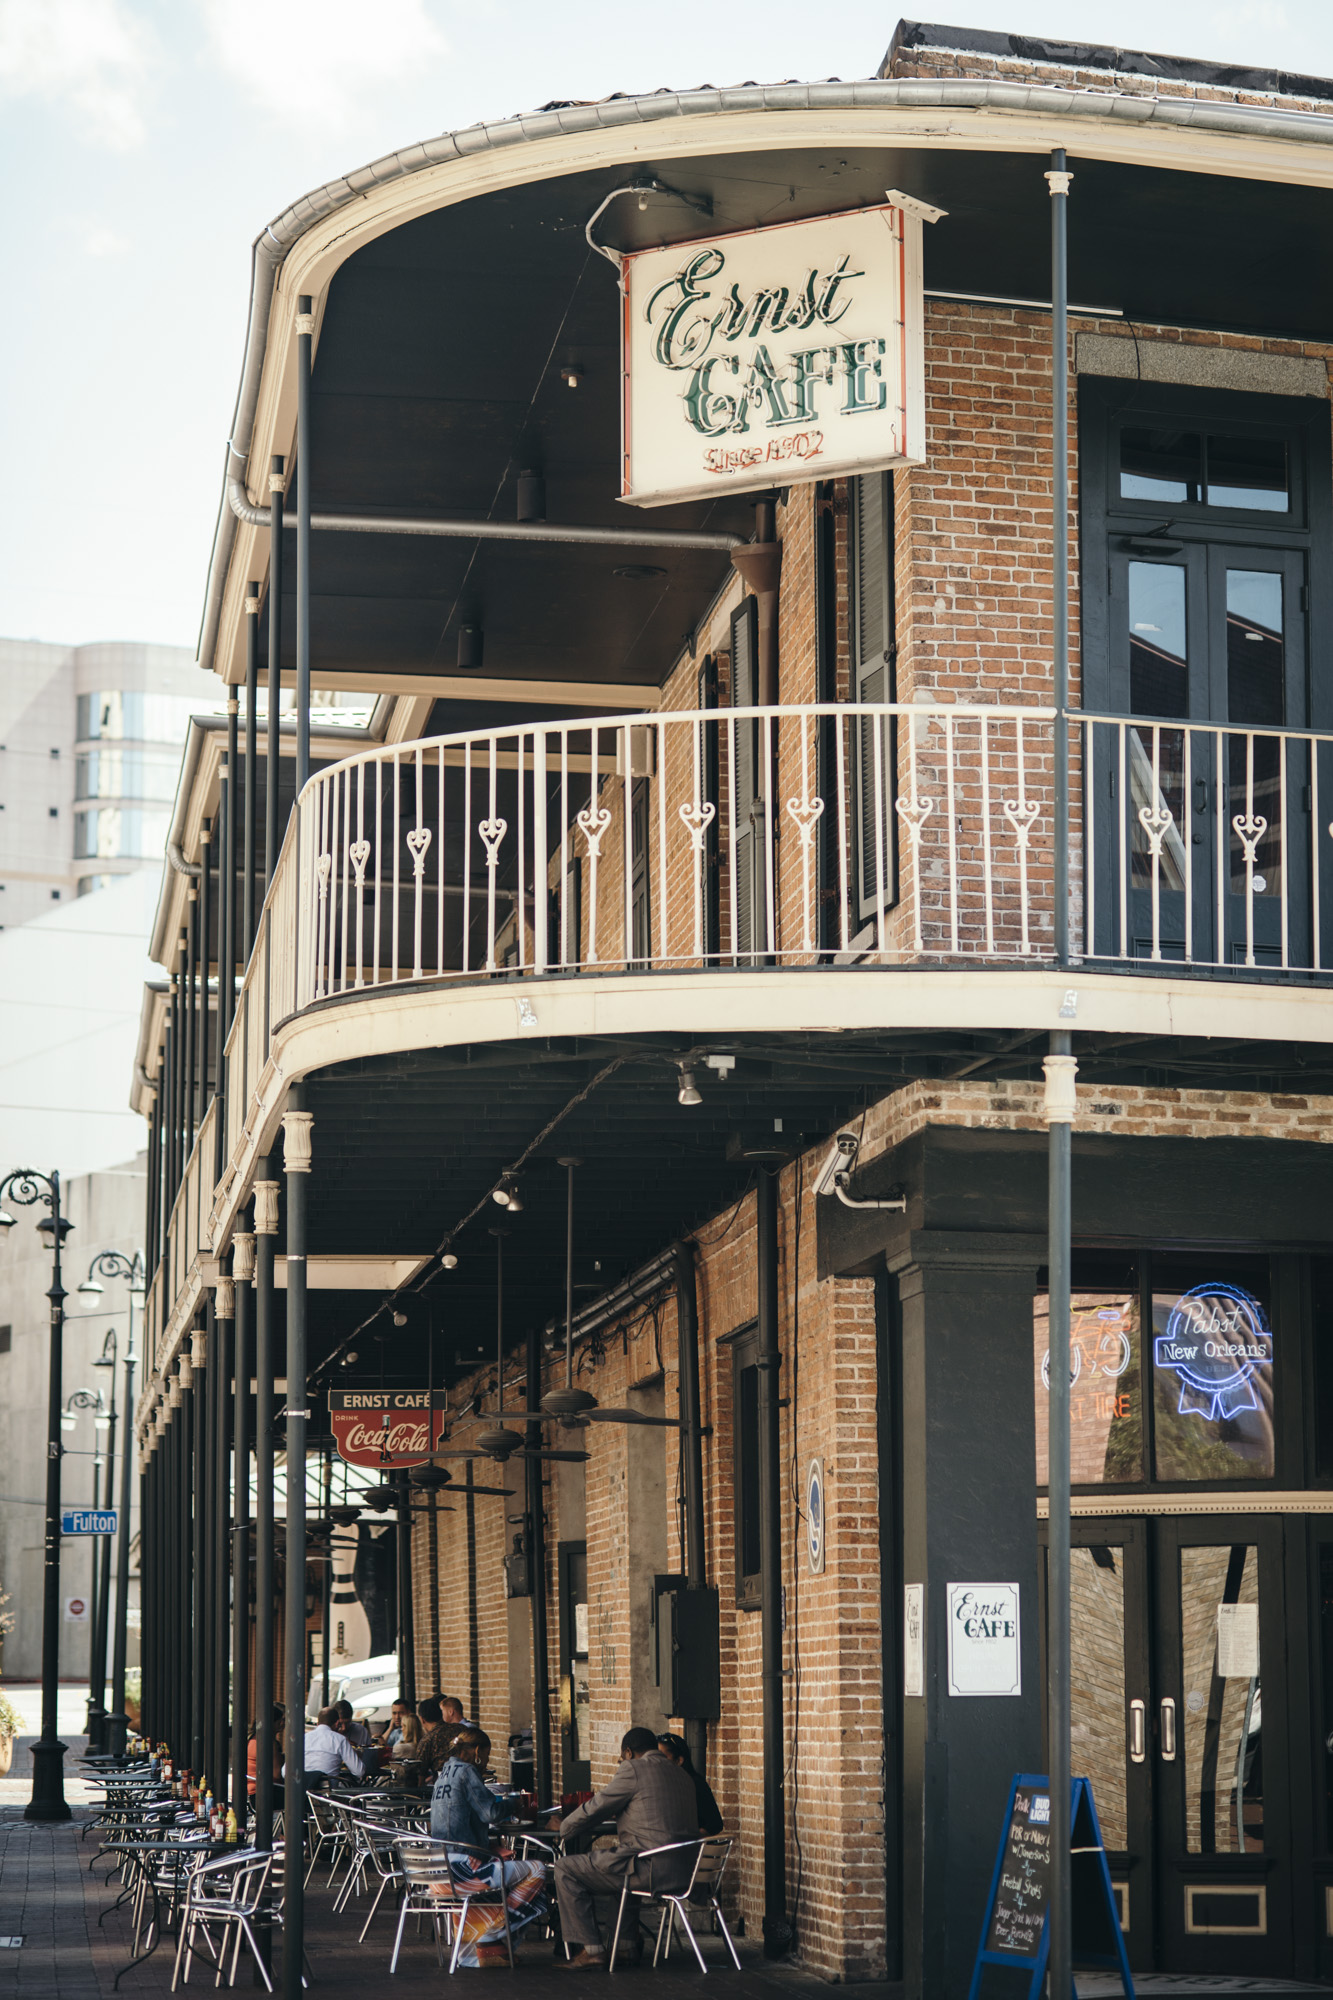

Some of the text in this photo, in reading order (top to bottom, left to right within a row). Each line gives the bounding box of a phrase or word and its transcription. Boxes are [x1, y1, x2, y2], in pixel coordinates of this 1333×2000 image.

[643, 248, 865, 370] Ernst
[677, 336, 888, 438] CAFE
[703, 430, 824, 473] Since 1902
[1181, 1301, 1244, 1335] Pabst
[1162, 1340, 1267, 1361] New Orleans
[343, 1394, 391, 1408] ERNST
[1089, 1391, 1131, 1419] TIRE
[73, 1512, 116, 1531] Fulton
[954, 1592, 1009, 1621] Ernst
[964, 1617, 1015, 1638] CAFE
[1034, 1797, 1050, 1810] BUD
